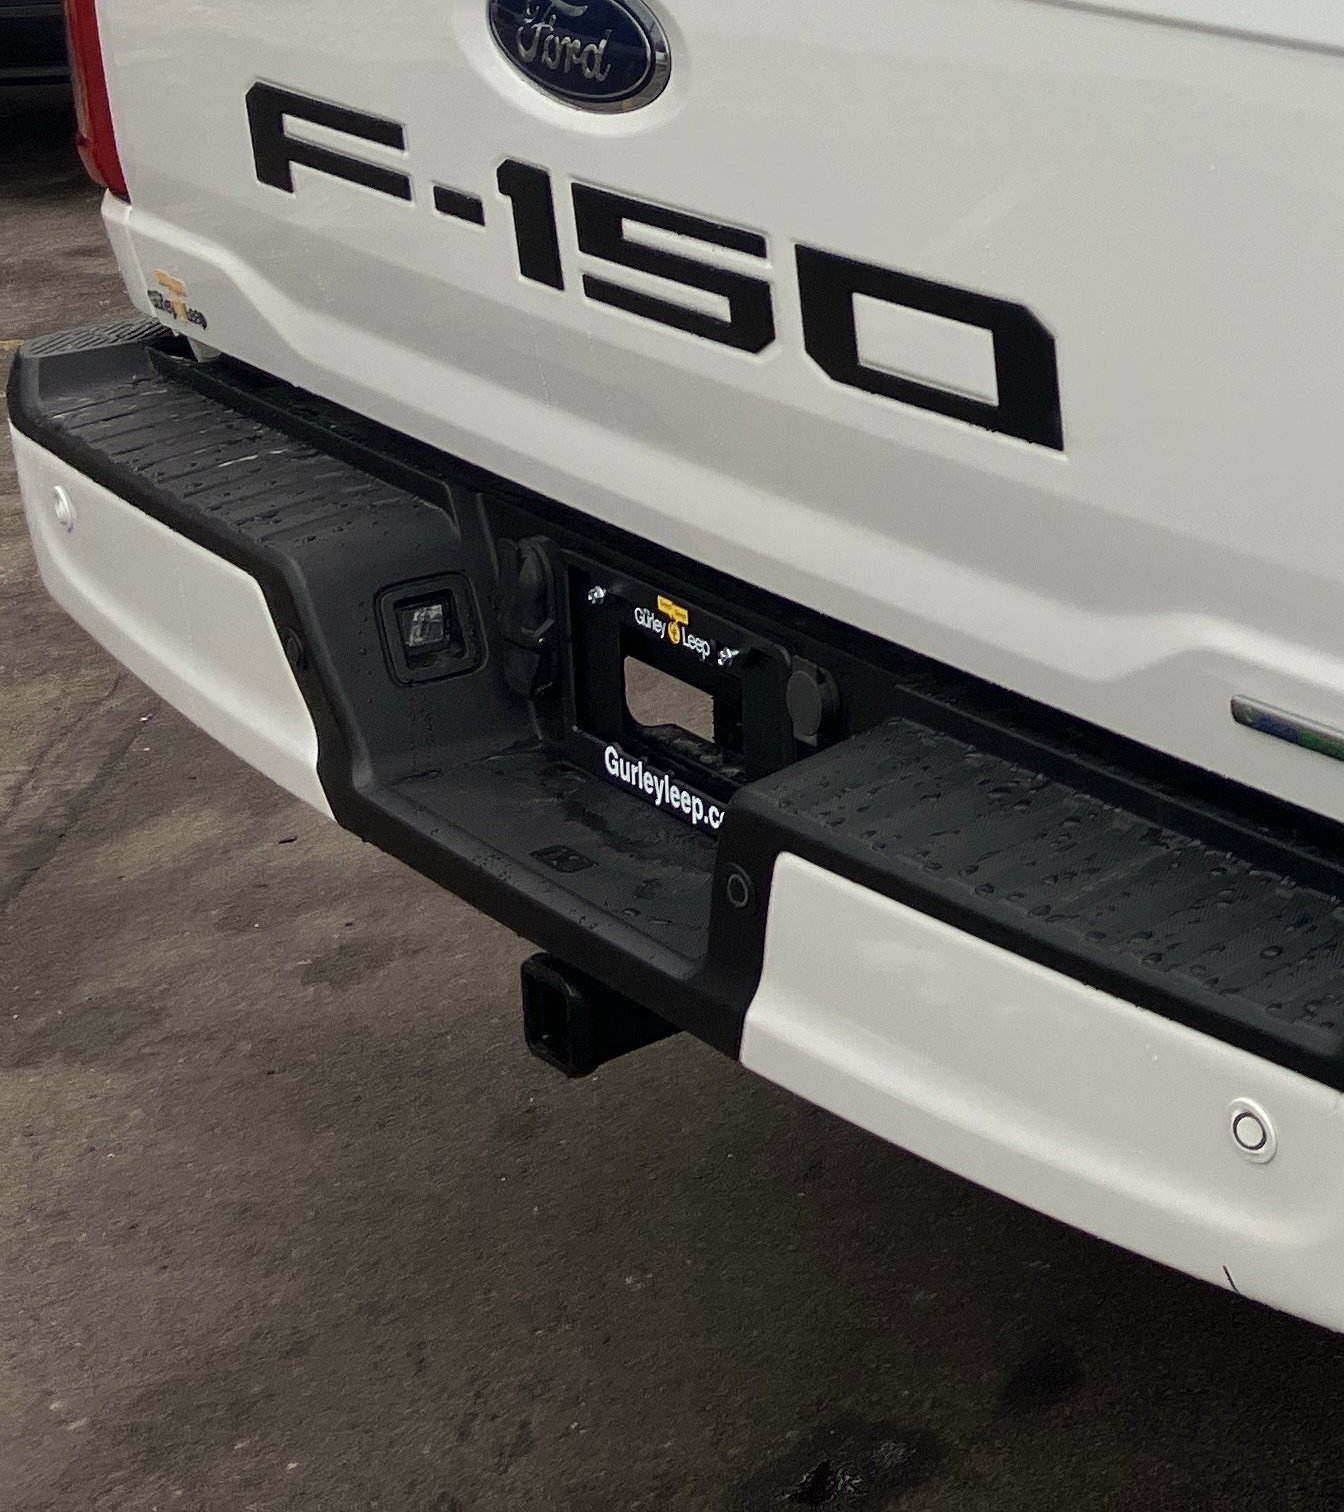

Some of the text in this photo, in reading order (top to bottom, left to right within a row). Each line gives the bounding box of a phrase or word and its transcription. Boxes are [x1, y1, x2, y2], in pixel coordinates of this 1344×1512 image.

[246, 79, 1066, 452] F-150
[681, 625, 711, 661] Leep
[604, 745, 725, 829] Gurleyleep.c
